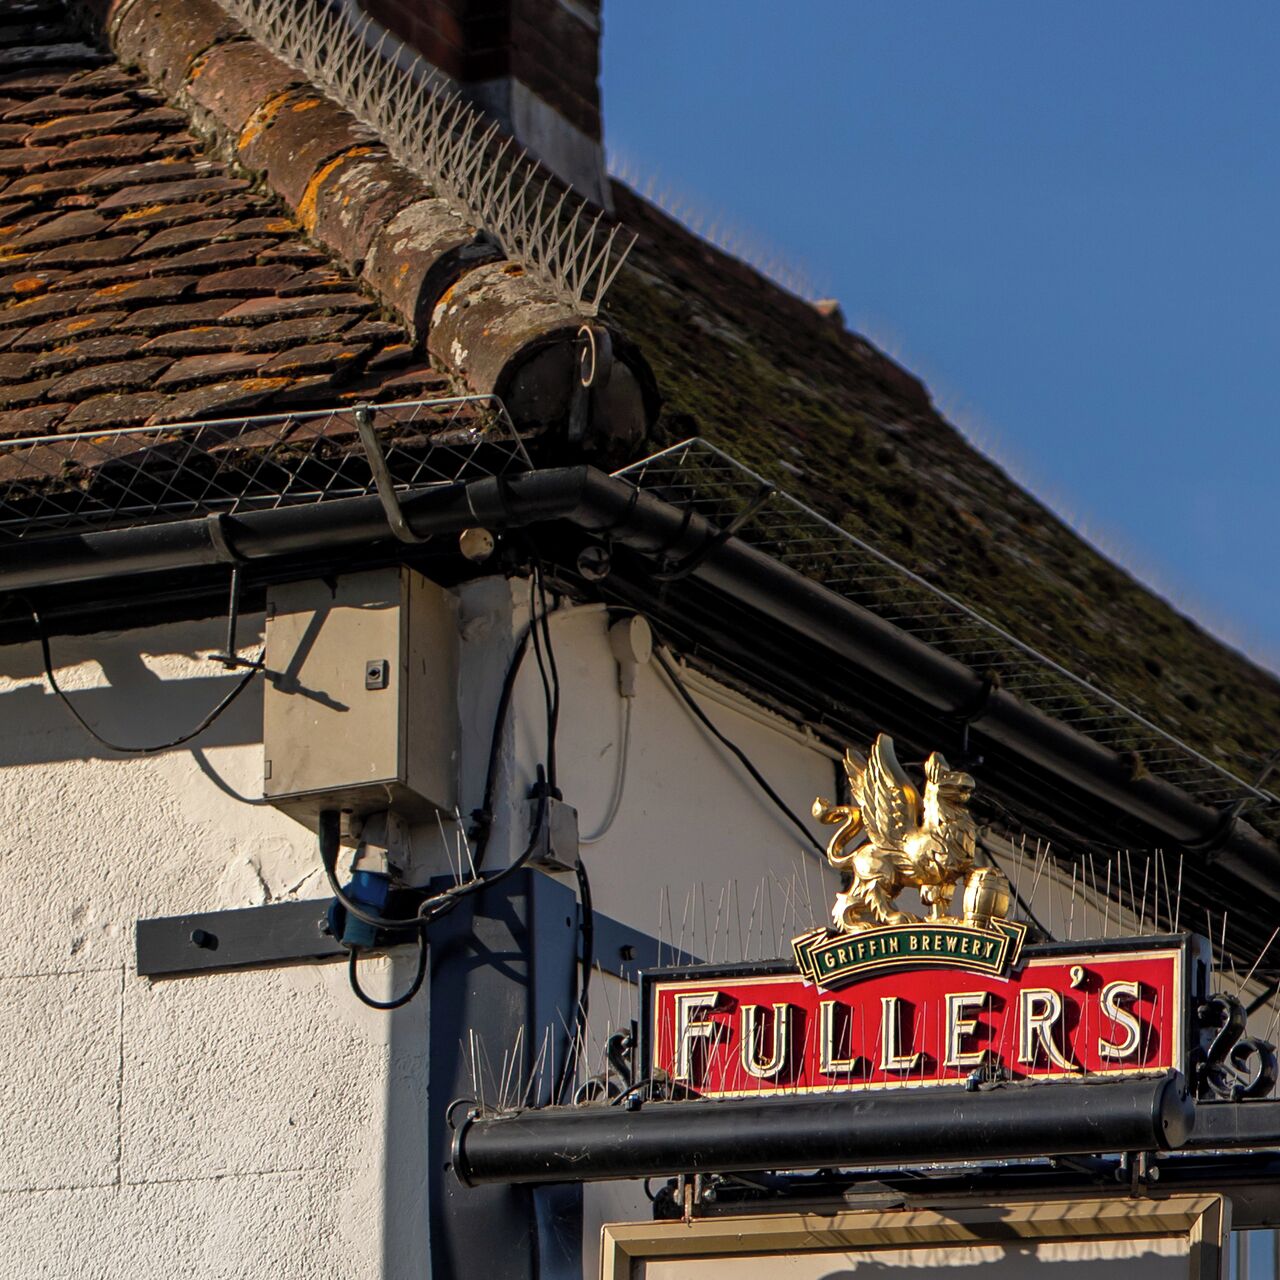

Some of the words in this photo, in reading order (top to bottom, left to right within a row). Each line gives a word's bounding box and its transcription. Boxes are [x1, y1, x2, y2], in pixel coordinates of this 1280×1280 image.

[824, 938, 899, 968] GRIFFIN
[909, 935, 994, 958] BREWERY
[674, 965, 1141, 1081] FULLER'S
